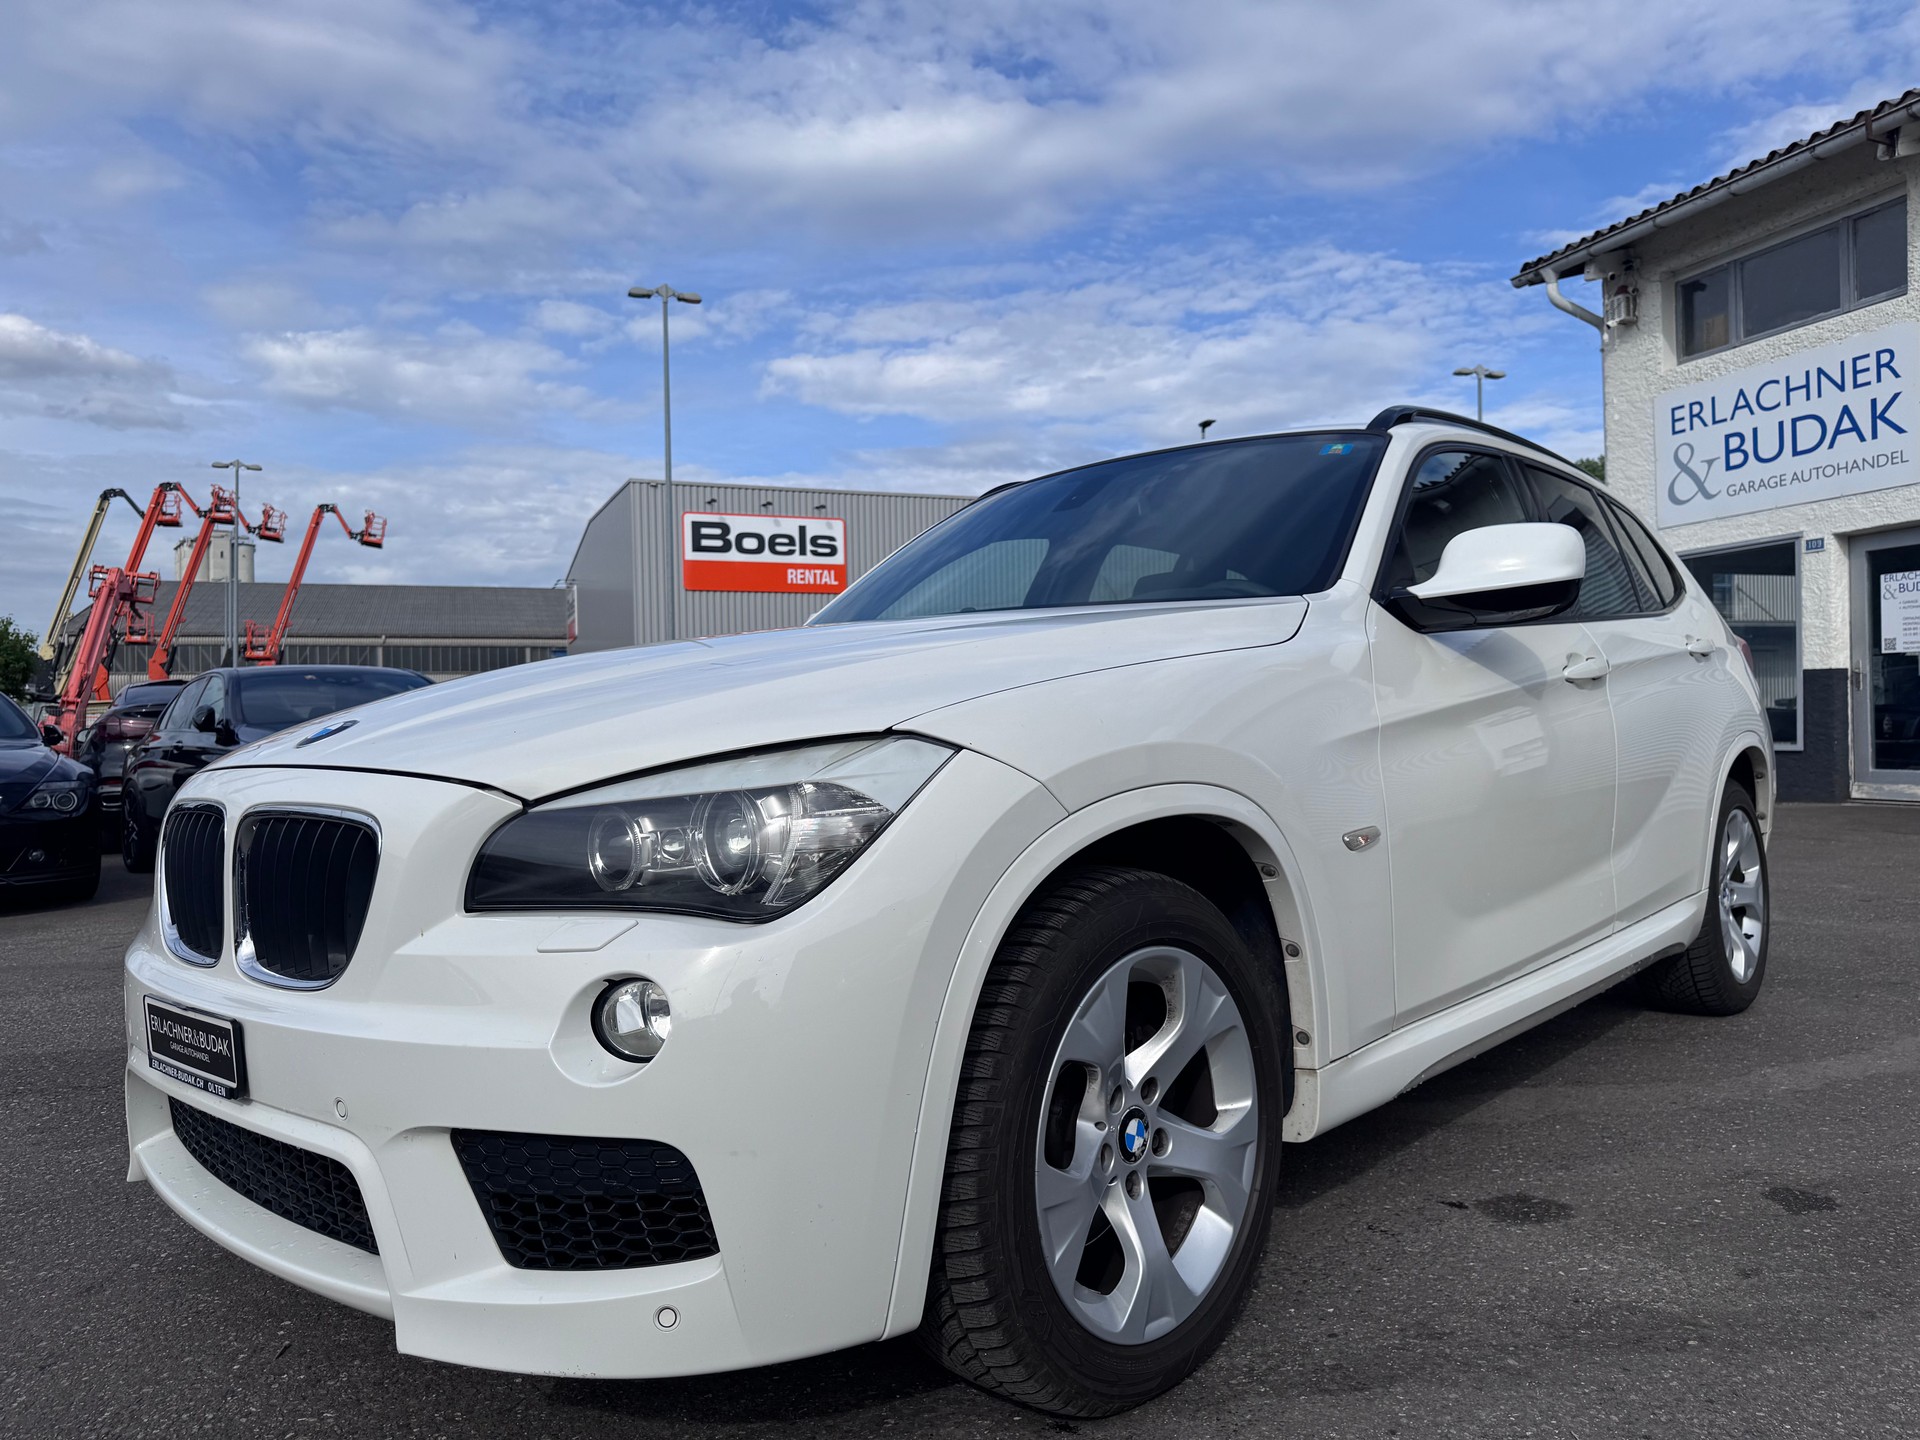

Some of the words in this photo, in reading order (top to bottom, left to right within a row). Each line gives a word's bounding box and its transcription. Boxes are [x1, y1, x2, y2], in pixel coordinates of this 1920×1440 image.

[1671, 348, 1902, 436] ERLACHNER
[1667, 442, 1721, 506] &
[1724, 391, 1908, 472] BUDAK
[1726, 473, 1787, 498] GARAGE
[1790, 450, 1909, 486] AUTOHANDEL
[691, 520, 838, 557] Boels
[787, 568, 838, 585] RENTAL
[208, 1082, 226, 1097] OLTEN
